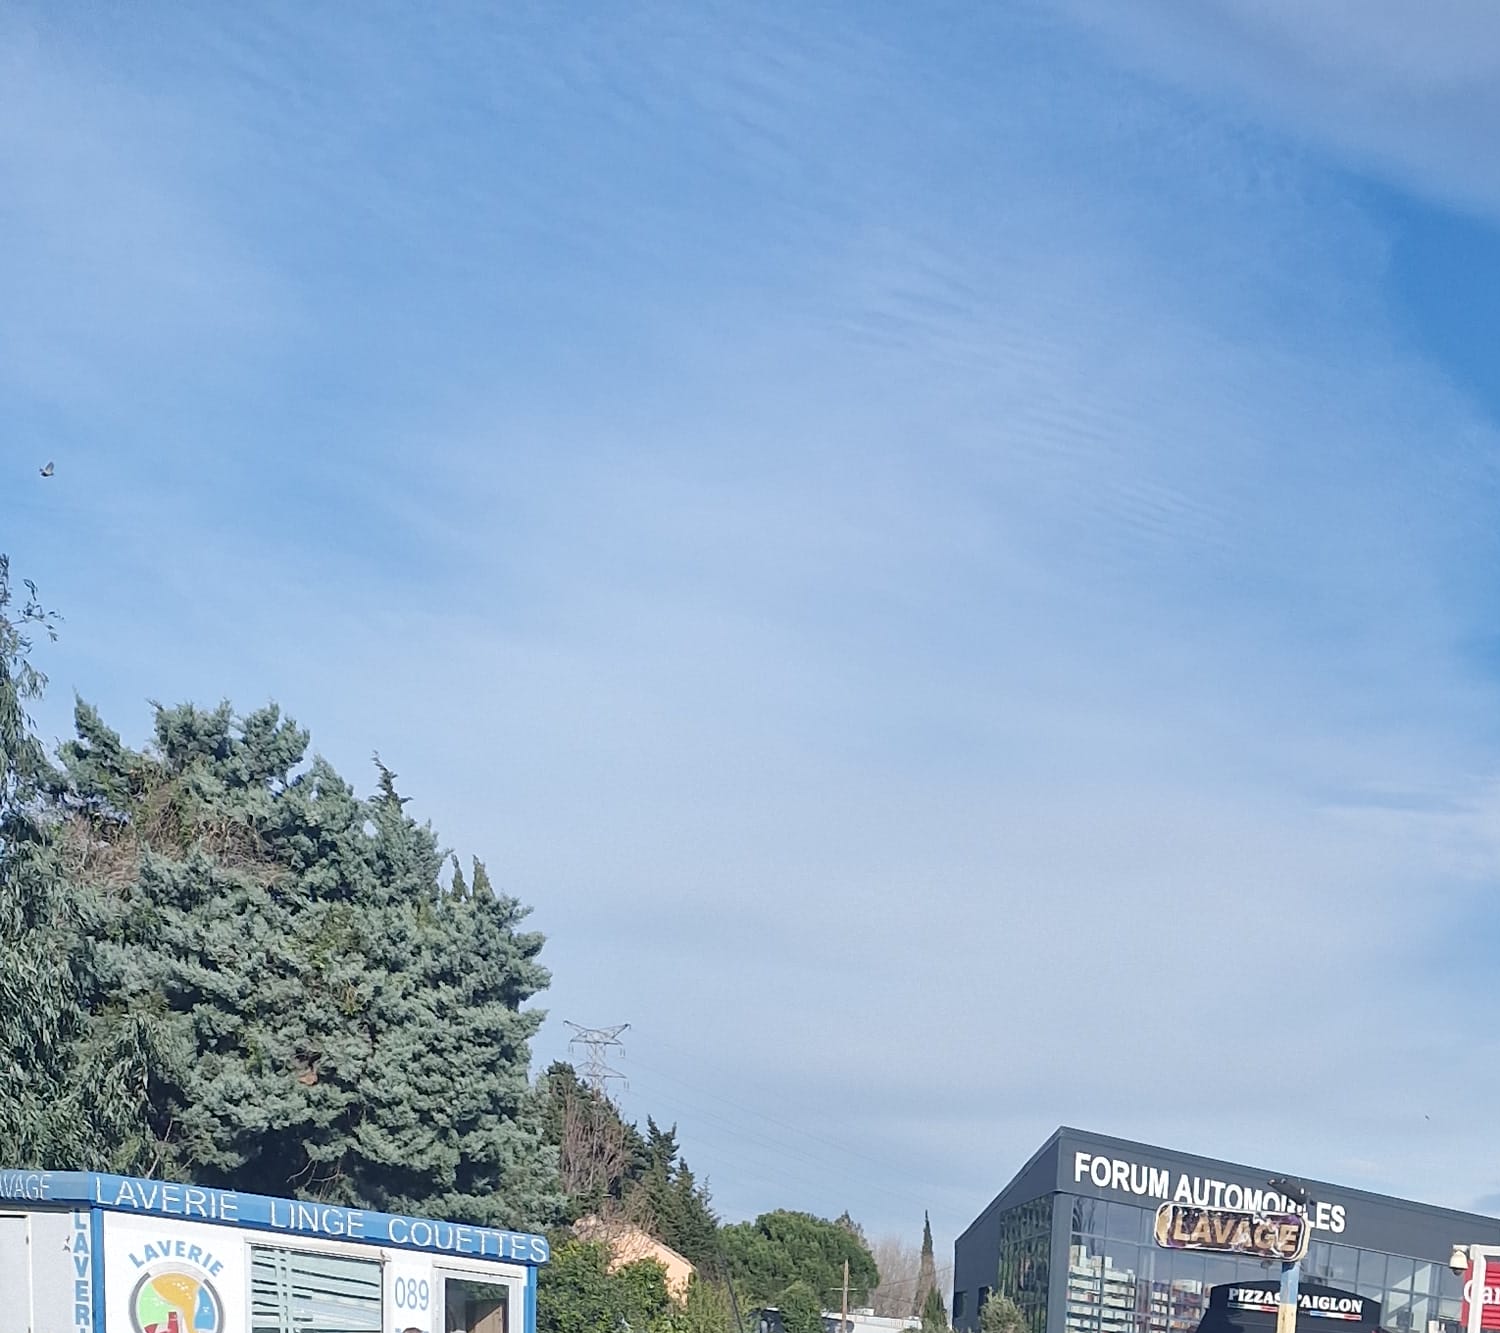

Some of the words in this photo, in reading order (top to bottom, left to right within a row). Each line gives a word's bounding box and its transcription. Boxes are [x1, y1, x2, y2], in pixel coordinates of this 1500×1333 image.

[0, 1173, 52, 1200] VAGE
[1074, 1151, 1170, 1199] FORUM
[96, 1177, 240, 1222] LAVERIE
[270, 1200, 366, 1239] LINGE
[388, 1218, 549, 1263] COUETTES
[1172, 1209, 1299, 1252] LAVAGE
[128, 1239, 224, 1278] LAVERIE
[395, 1276, 430, 1312] 089
[1296, 1293, 1363, 1314] 'AIGLON
